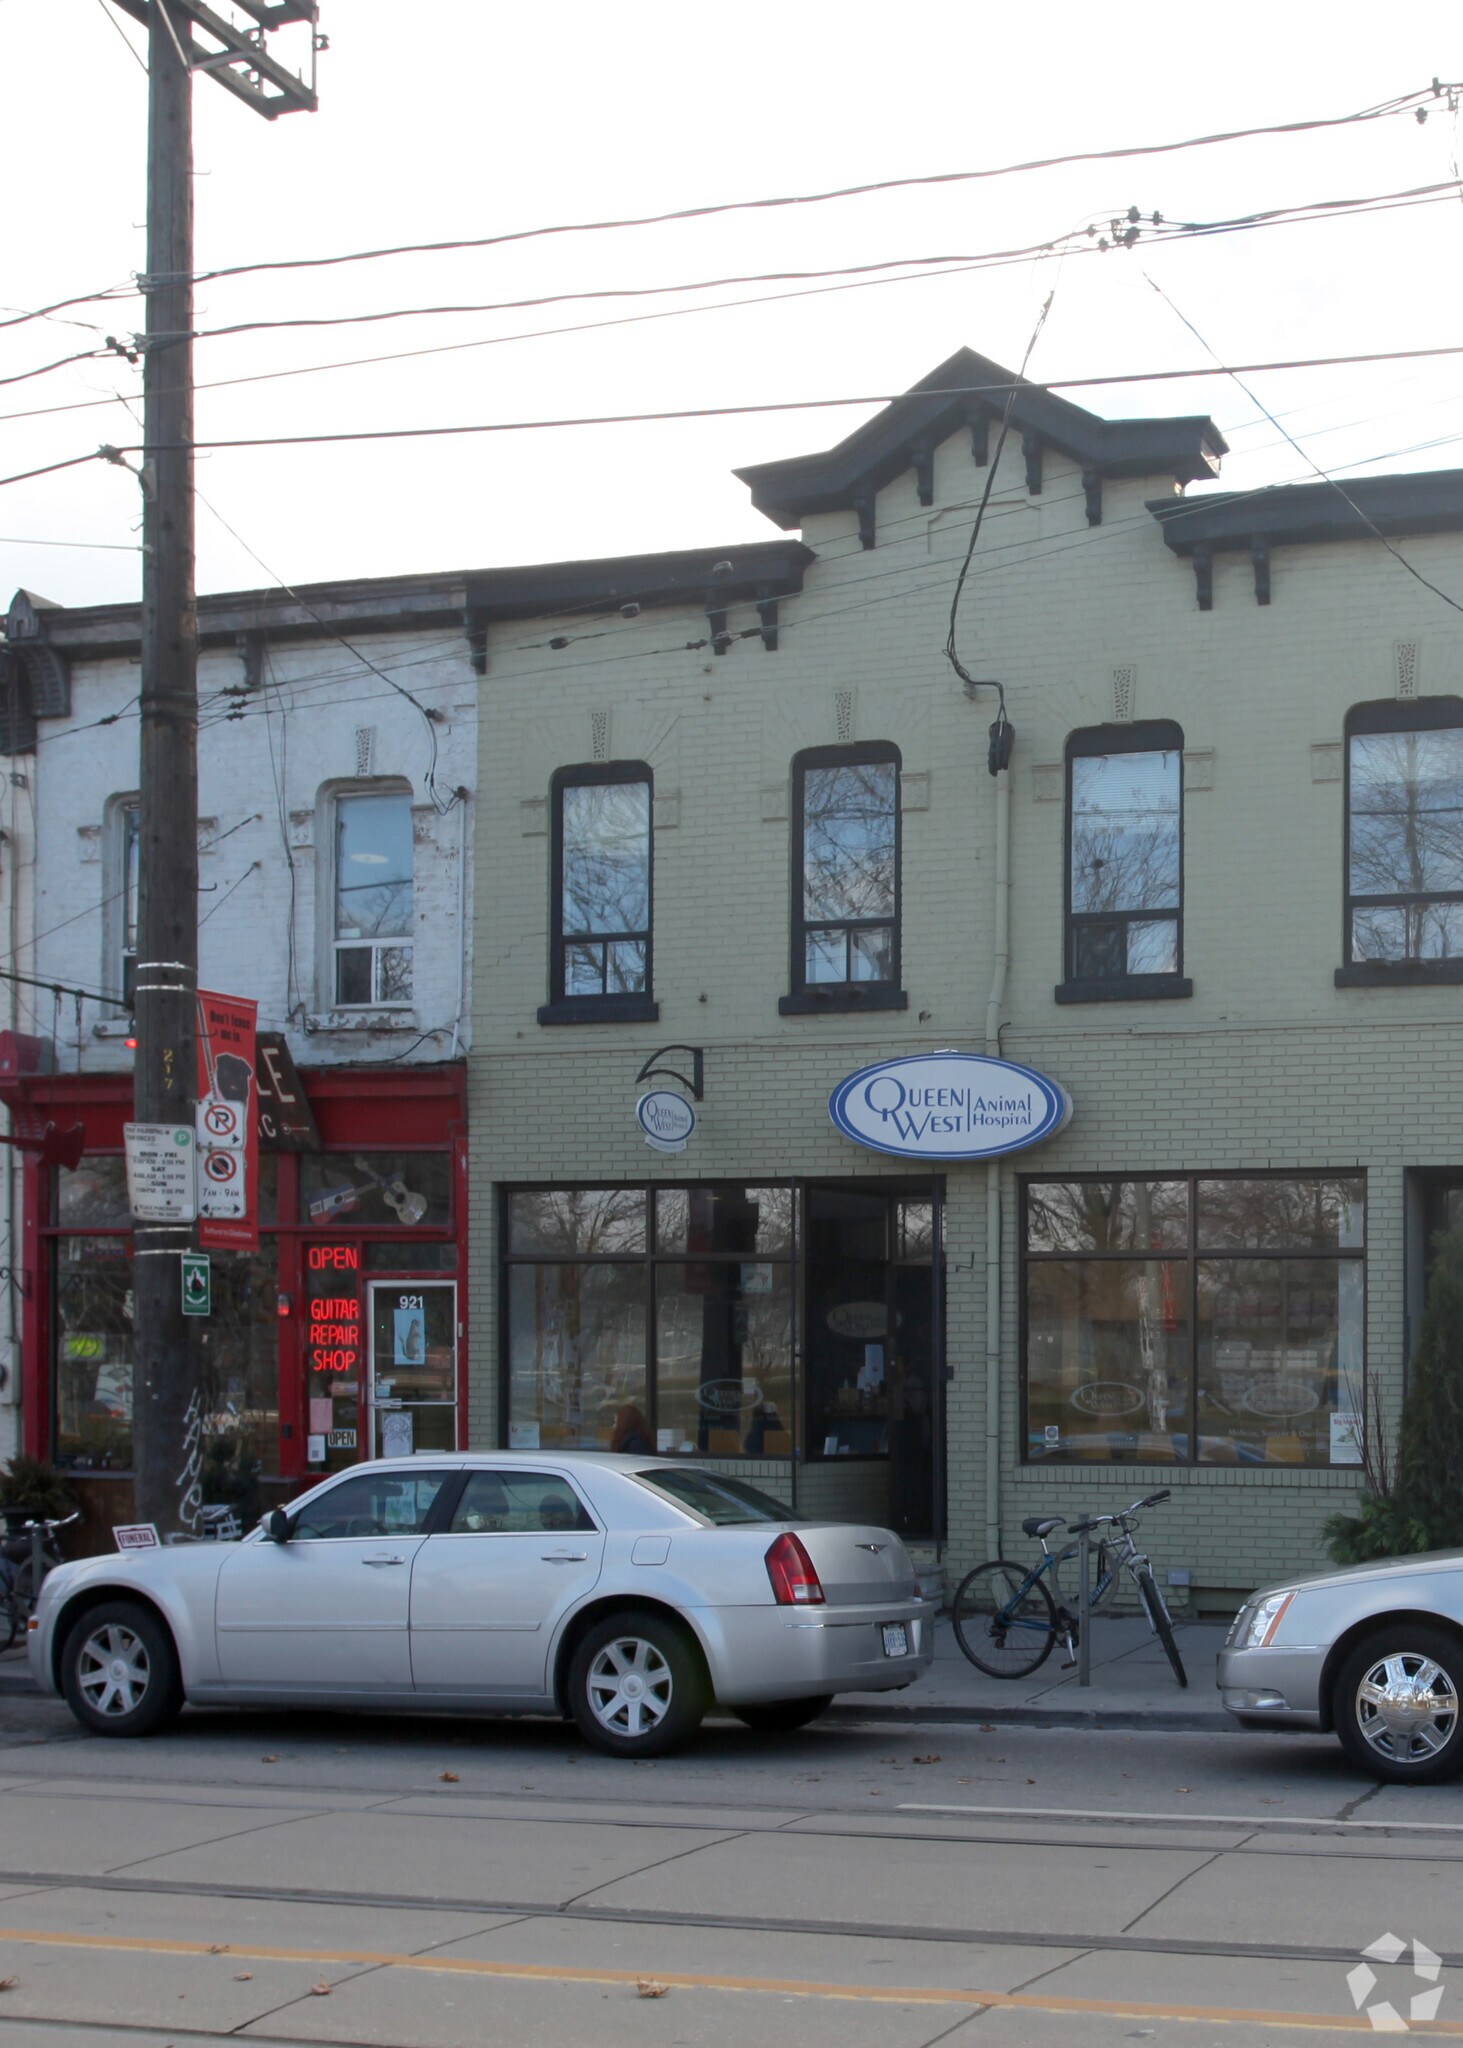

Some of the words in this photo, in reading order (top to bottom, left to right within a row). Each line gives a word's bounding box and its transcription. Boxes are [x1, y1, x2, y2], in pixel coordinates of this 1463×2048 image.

[864, 1076, 964, 1121] QUEEN
[892, 1111, 963, 1141] WEST
[202, 1187, 217, 1197] 7AM
[224, 1188, 240, 1197] 9AM
[308, 1246, 358, 1270] OPEN
[310, 1298, 359, 1320] GUITAR
[399, 1295, 424, 1309] 921
[310, 1324, 359, 1346] REPAIR
[313, 1349, 356, 1371] SHOP
[329, 1431, 354, 1446] OPEN
[121, 1531, 152, 1544] FUNERAL
